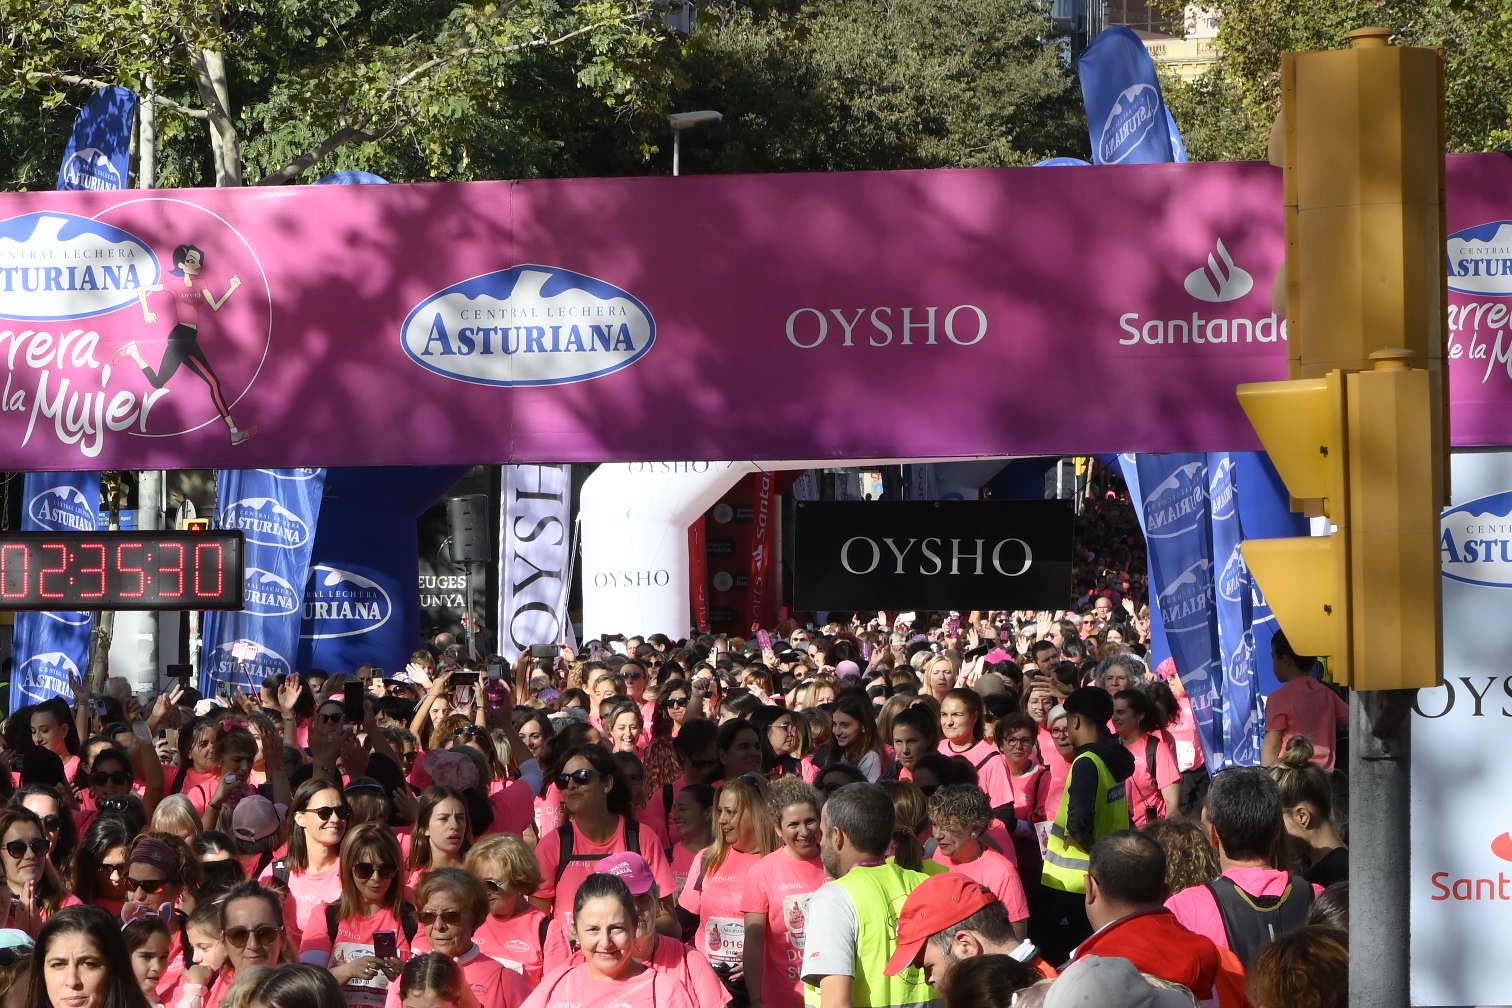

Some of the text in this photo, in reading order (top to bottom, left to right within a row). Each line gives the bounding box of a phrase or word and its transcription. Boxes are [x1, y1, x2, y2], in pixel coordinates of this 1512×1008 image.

[64, 248, 136, 259] LECHERA
[460, 305, 629, 321] CENTRAL LECHERA
[785, 304, 988, 349] OYSHO
[1118, 311, 1288, 345] Santande
[420, 312, 636, 357] ASTURIANA
[1, 373, 26, 412] la
[21, 363, 170, 457] Mujer
[225, 511, 300, 542] ASTURIANA
[1, 543, 223, 598] 02:35:30
[510, 464, 564, 652] OYSH
[840, 536, 1033, 577] OYSHO
[594, 570, 670, 588] OYSHO
[723, 940, 743, 949] 016
